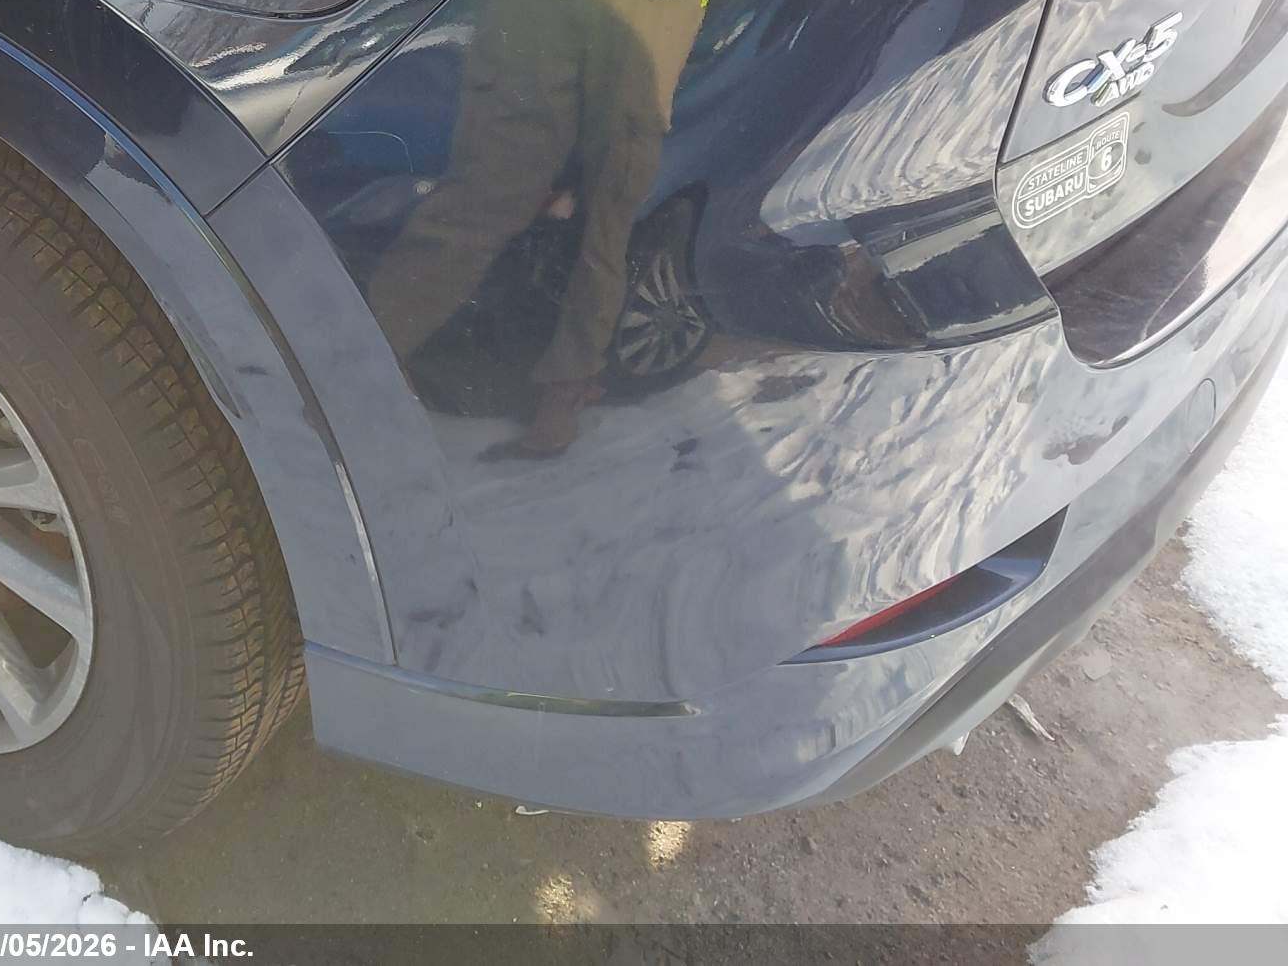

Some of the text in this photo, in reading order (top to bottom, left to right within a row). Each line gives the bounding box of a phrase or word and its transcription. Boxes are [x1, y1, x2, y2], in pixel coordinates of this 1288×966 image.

[1043, 11, 1183, 107] CX-5
[1028, 151, 1085, 190] STATELINE
[1101, 146, 1114, 172] 6
[1025, 172, 1085, 217] SUBARU
